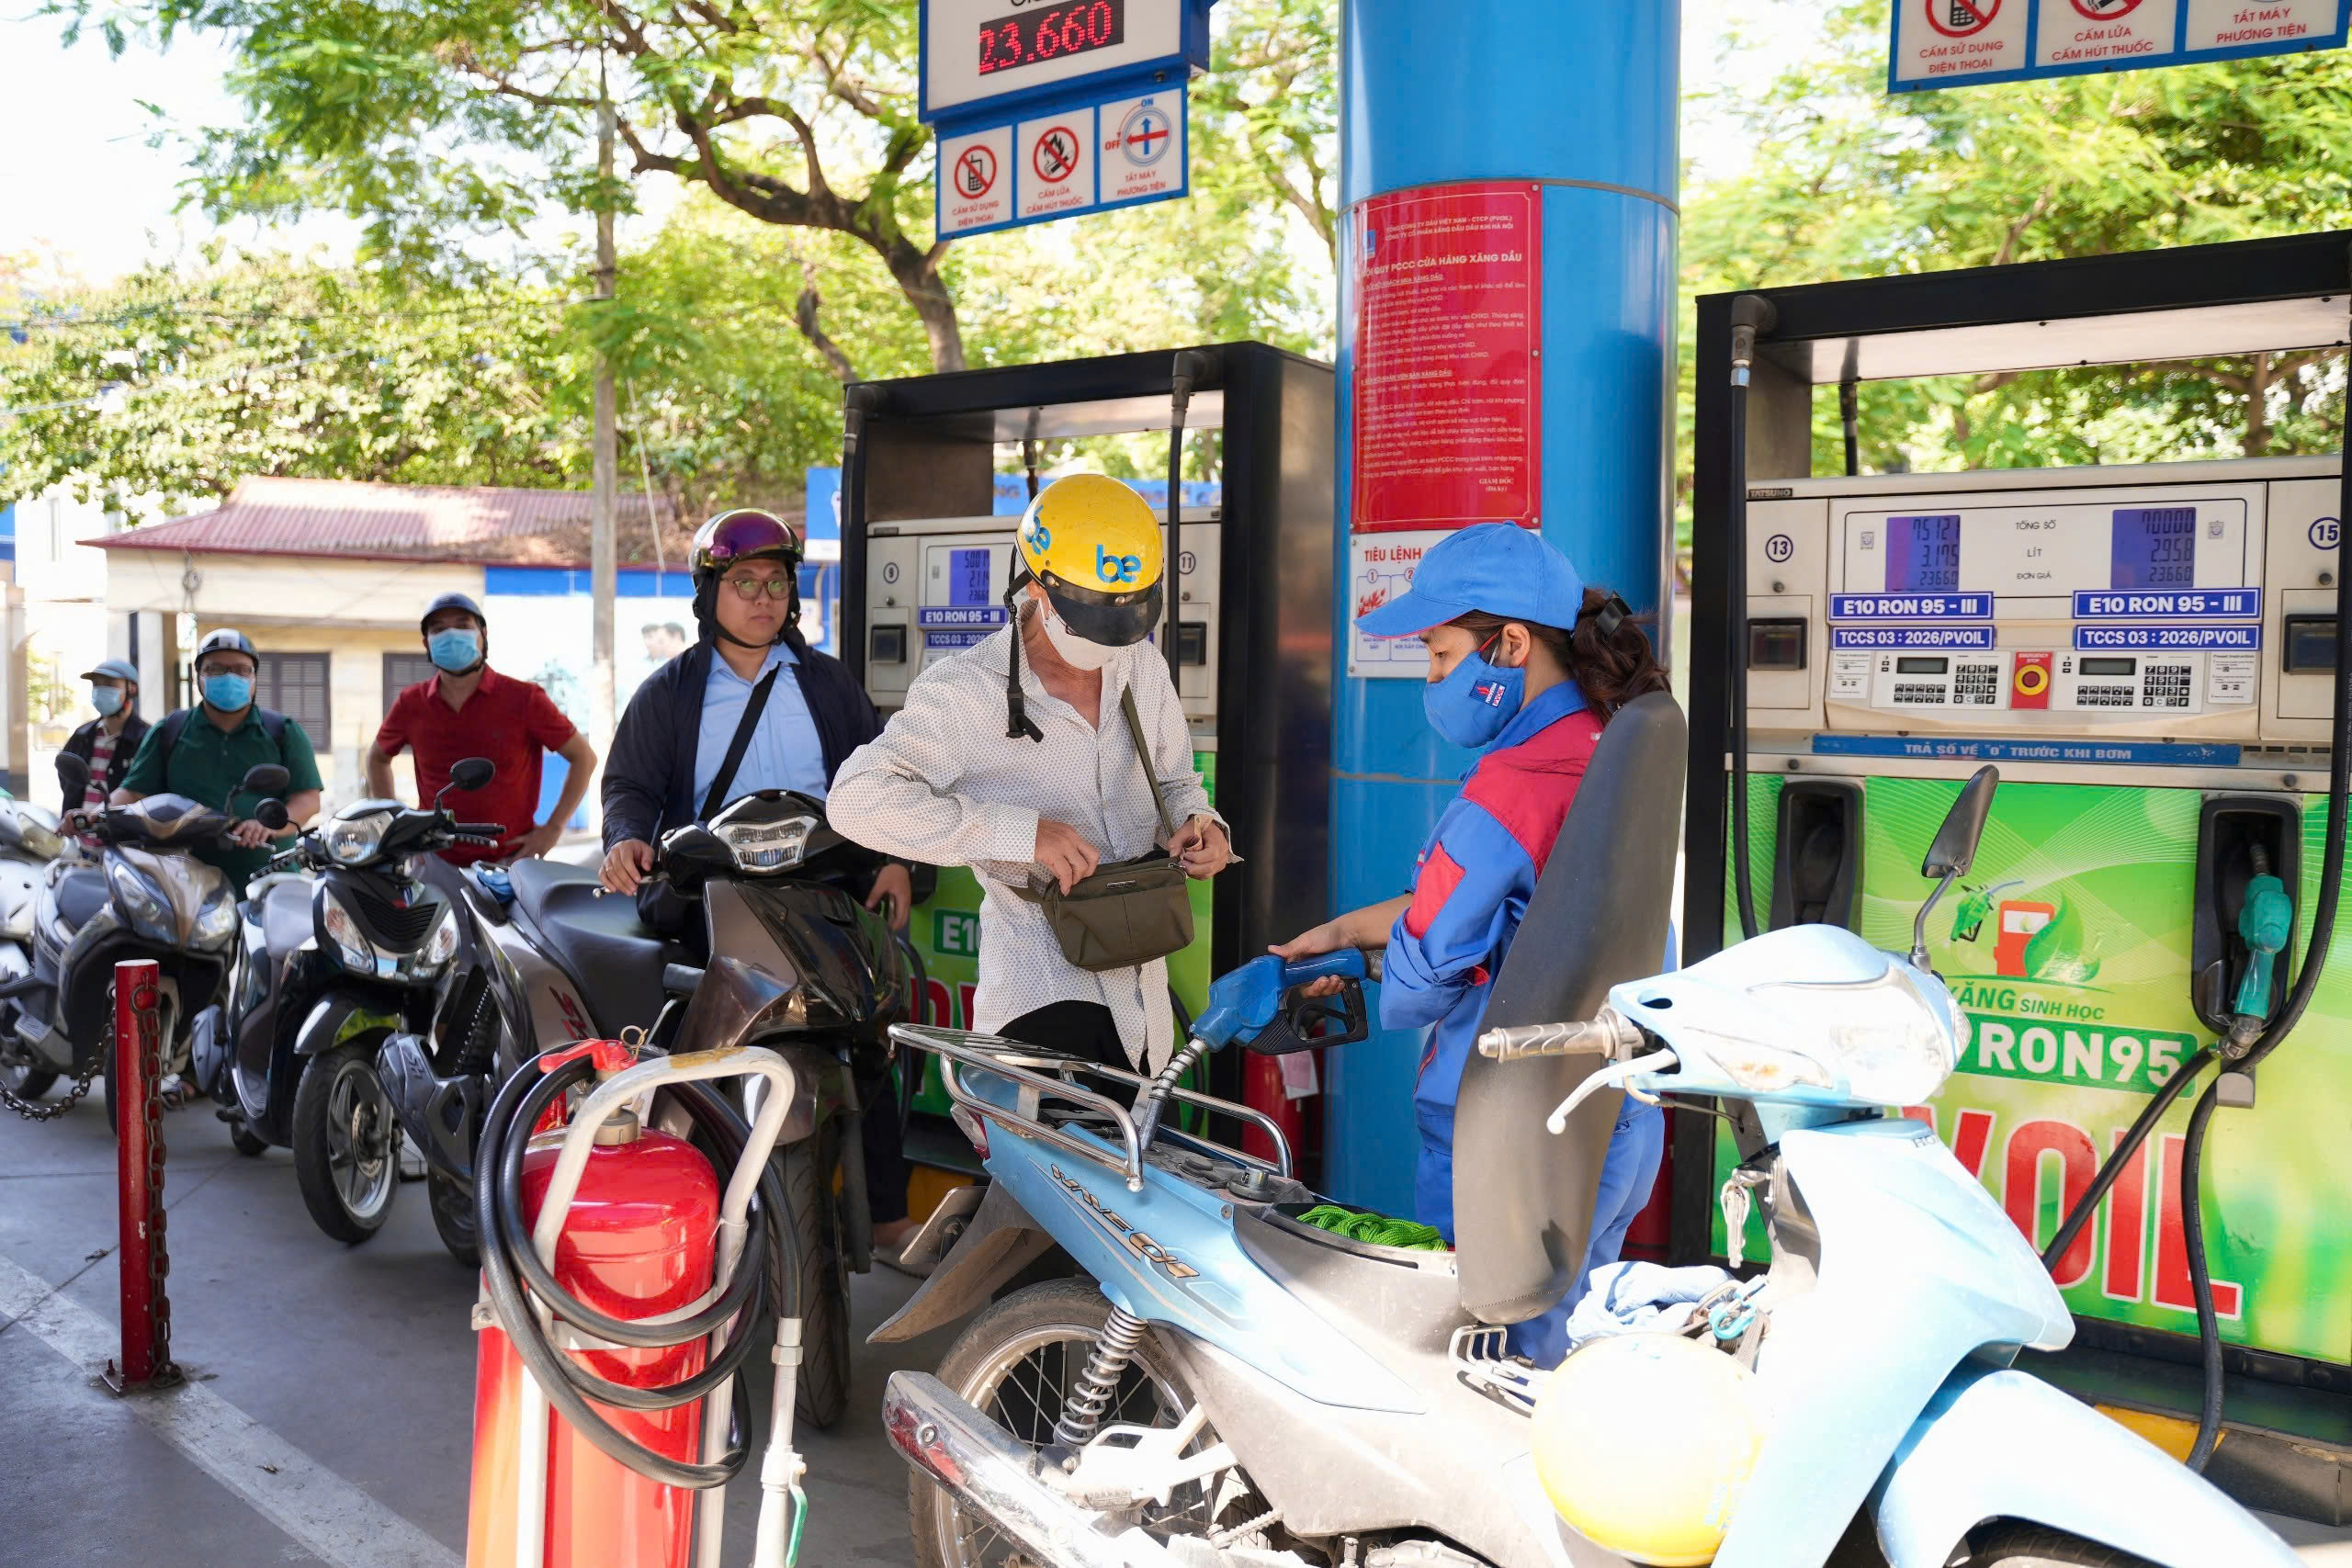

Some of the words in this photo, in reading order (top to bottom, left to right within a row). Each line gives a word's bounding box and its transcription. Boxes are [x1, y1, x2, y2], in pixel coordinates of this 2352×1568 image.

[2233, 10, 2256, 24] TẮT
[2258, 7, 2290, 22] MÁY
[978, 1, 1112, 73] 23.660
[2075, 26, 2105, 42] CẤM
[2108, 23, 2132, 39] LỬA
[2217, 26, 2275, 44] PHƯƠNG
[2277, 23, 2307, 39] TIỆN
[1919, 43, 1948, 59] CẤM
[1950, 40, 1967, 57] SỬ
[1967, 40, 2004, 56] DỤNG
[2052, 45, 2082, 62] CẤM
[2085, 42, 2110, 58] HÚT
[2112, 38, 2154, 56] THUỐC
[1928, 60, 1957, 74] ĐIỆN
[1959, 57, 1994, 72] THOẠI
[1140, 98, 1154, 108] ON
[1105, 140, 1122, 151] OFF
[1038, 186, 1056, 199] CẤM
[1116, 183, 1148, 197] PHƯƠNG
[1391, 260, 1416, 272] PCCC
[1417, 255, 1437, 268] CỬA
[1439, 253, 1467, 265] HÀNG
[1470, 253, 1498, 263] XĂNG
[1501, 250, 1522, 262] DẦU
[1749, 489, 1791, 498] TATSUNO
[2016, 520, 2040, 530] TỔNG
[2043, 519, 2056, 529] SỐ
[2317, 525, 2338, 541] 15
[1364, 546, 1385, 562] TIÊU
[1390, 546, 1421, 564] LỆNH
[1771, 540, 1788, 555] 13
[1096, 544, 1142, 583] be
[1182, 557, 1192, 570] 11
[888, 569, 894, 579] 9
[1371, 571, 1374, 581] 1
[1408, 570, 1414, 579] 2
[1919, 571, 1958, 585] 23660
[2037, 570, 2052, 580] GIÁ
[2149, 566, 2191, 581] 23660
[1844, 600, 1875, 615] E10
[1878, 600, 1917, 615] RON
[1921, 599, 1945, 614] 95
[1961, 599, 1977, 614] III
[2088, 597, 2124, 613] E10
[2128, 597, 2174, 613] RON
[2177, 596, 2204, 612] 95
[2223, 595, 2242, 611] III
[926, 611, 944, 622] E10
[944, 611, 967, 622] RON
[968, 611, 982, 622] 95
[990, 611, 1000, 622] III
[930, 635, 950, 644] TCCS
[951, 635, 961, 644] 03
[1839, 632, 1875, 644] TCCS
[1878, 631, 1895, 644] 03
[1905, 631, 1985, 646] 2026/PVOIL
[2085, 631, 2126, 644] TCCS
[2128, 630, 2148, 644] 03
[2160, 630, 2250, 646] 2026/PVOIL
[1905, 741, 1932, 753] TRẢ
[1937, 742, 1956, 754] SỐ
[2009, 745, 2060, 757] TRƯỚC
[2064, 749, 2090, 758] KHI
[2095, 748, 2132, 760] BƠM
[943, 915, 980, 951] E1
[2019, 998, 2063, 1016] SINH
[2065, 1003, 2105, 1021] HỌC
[1978, 1021, 2183, 1088] RON95
[1051, 1163, 1134, 1232] WAVE
